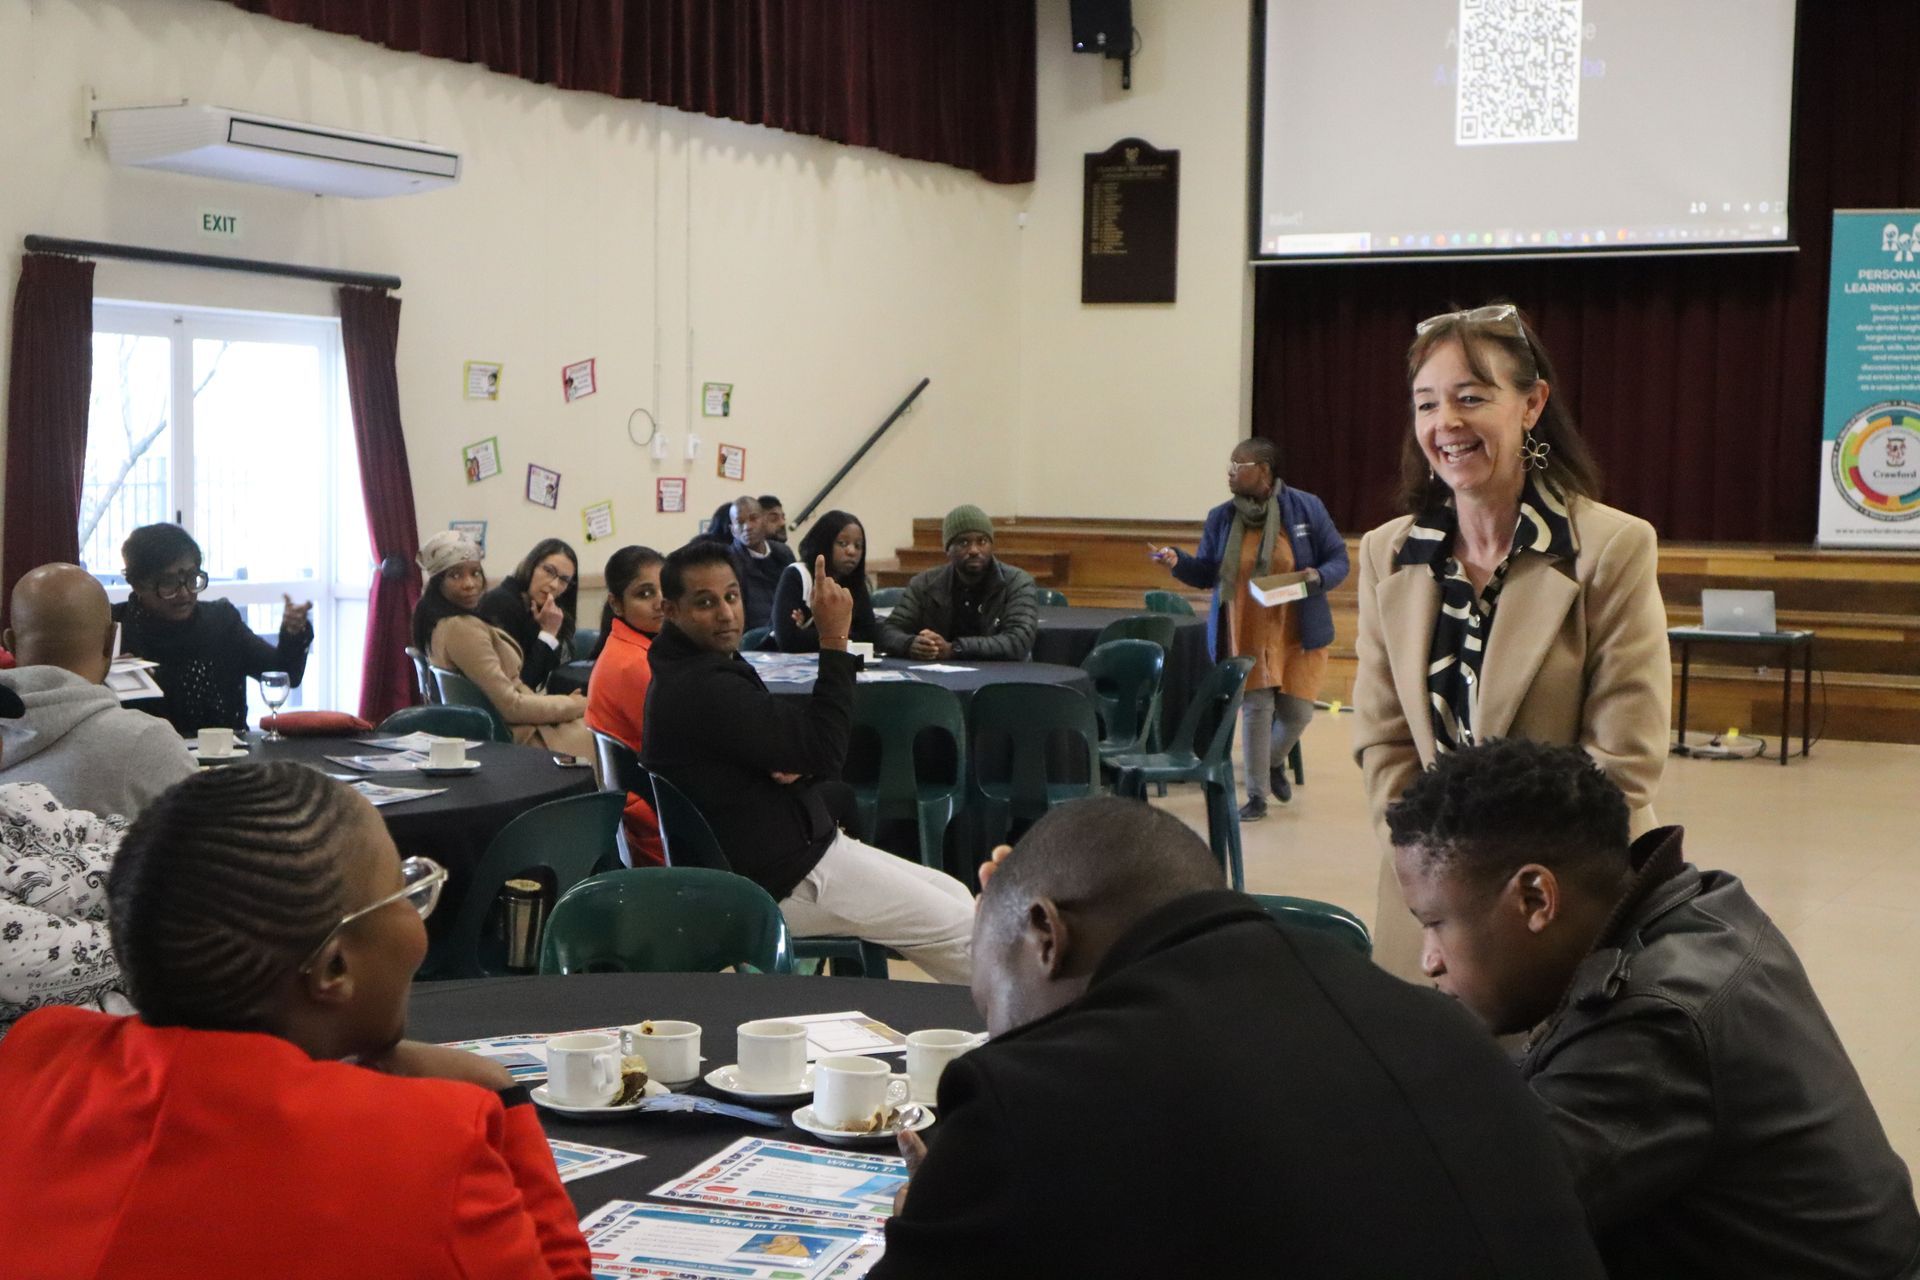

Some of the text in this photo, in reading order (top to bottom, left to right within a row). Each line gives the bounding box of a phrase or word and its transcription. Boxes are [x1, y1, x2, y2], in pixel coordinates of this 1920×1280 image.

[203, 213, 237, 233] EXIT
[1844, 282, 1904, 293] LEARNING
[1872, 469, 1917, 478] Crawford
[826, 1159, 855, 1167] Who
[710, 1218, 740, 1226] Who
